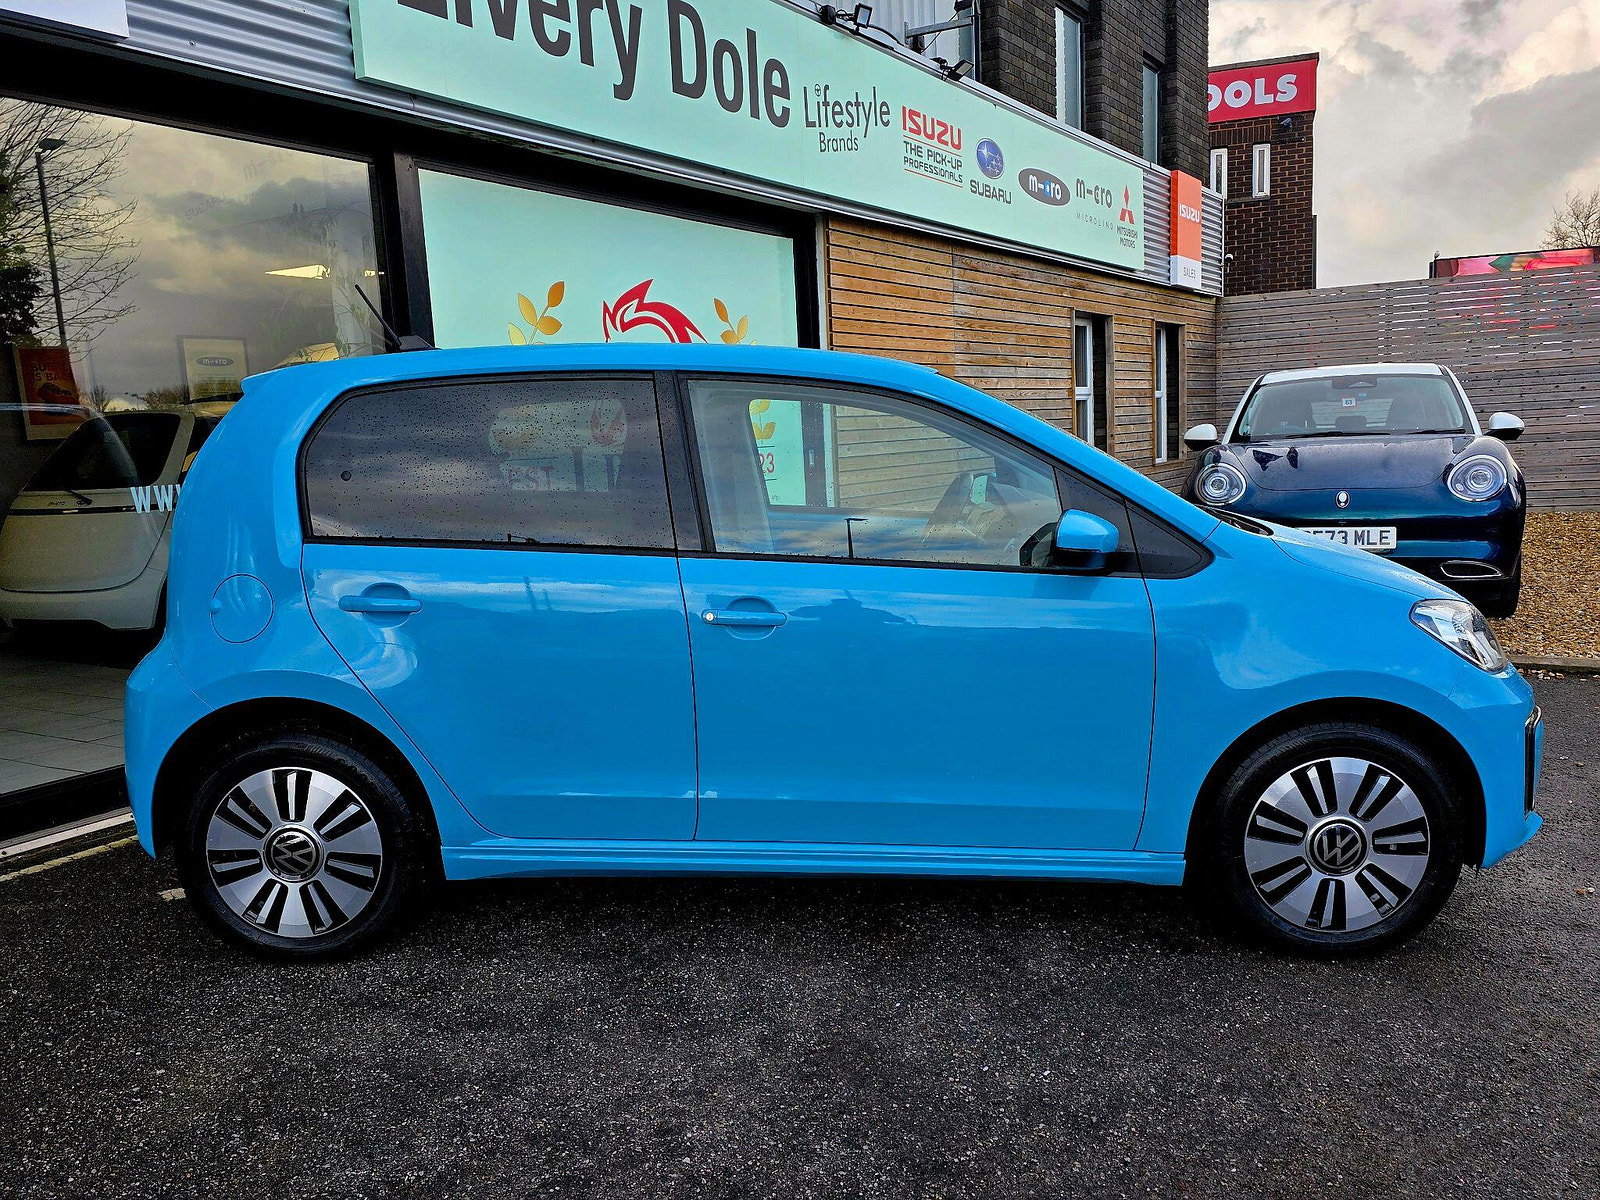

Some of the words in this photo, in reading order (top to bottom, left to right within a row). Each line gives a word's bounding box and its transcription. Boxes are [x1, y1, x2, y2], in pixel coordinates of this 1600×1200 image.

[398, 0, 642, 100] ery
[668, 0, 791, 128] Dole
[803, 83, 890, 138] Lifestyle
[819, 130, 859, 152] Brands
[902, 105, 962, 151] ISUZU
[903, 140, 923, 158] THE
[927, 148, 962, 171] PICK-UP
[903, 156, 963, 183] PROFESSIONALS
[969, 179, 1012, 204] SUBARU
[1180, 203, 1200, 223] ISUZU
[1119, 236, 1136, 249] MOTORS
[130, 484, 181, 514] WW
[1304, 530, 1348, 545] 73
[1354, 530, 1391, 546] MLE
